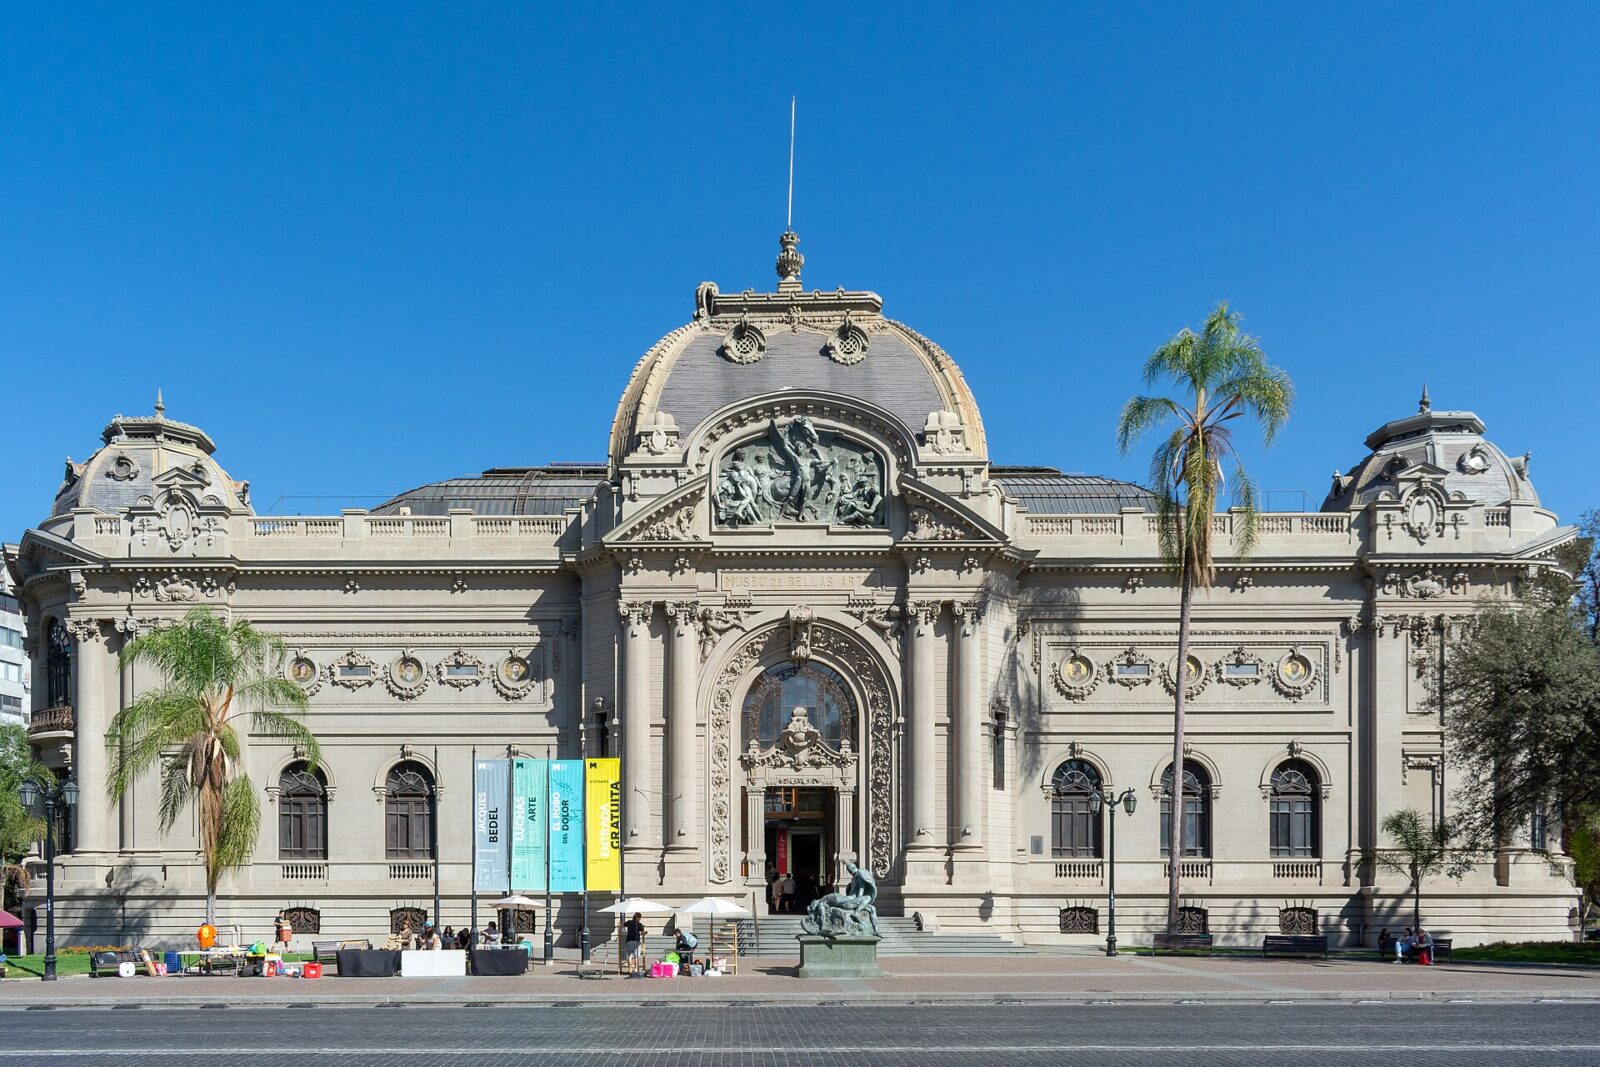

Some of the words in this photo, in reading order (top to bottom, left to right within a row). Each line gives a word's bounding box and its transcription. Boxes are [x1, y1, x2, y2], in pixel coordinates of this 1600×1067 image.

[725, 576, 765, 588] MUSEO
[771, 578, 783, 587] DE
[788, 576, 834, 588] BELLAS
[478, 792, 487, 834] JACQUES
[489, 807, 498, 843] BEDEL
[515, 796, 525, 841] LUCHAS
[528, 797, 537, 822] ARTE
[553, 820, 560, 831] EL
[561, 800, 569, 831] DOLOR
[611, 781, 620, 850] GRATUITA
[600, 803, 609, 858] ENTRADA
